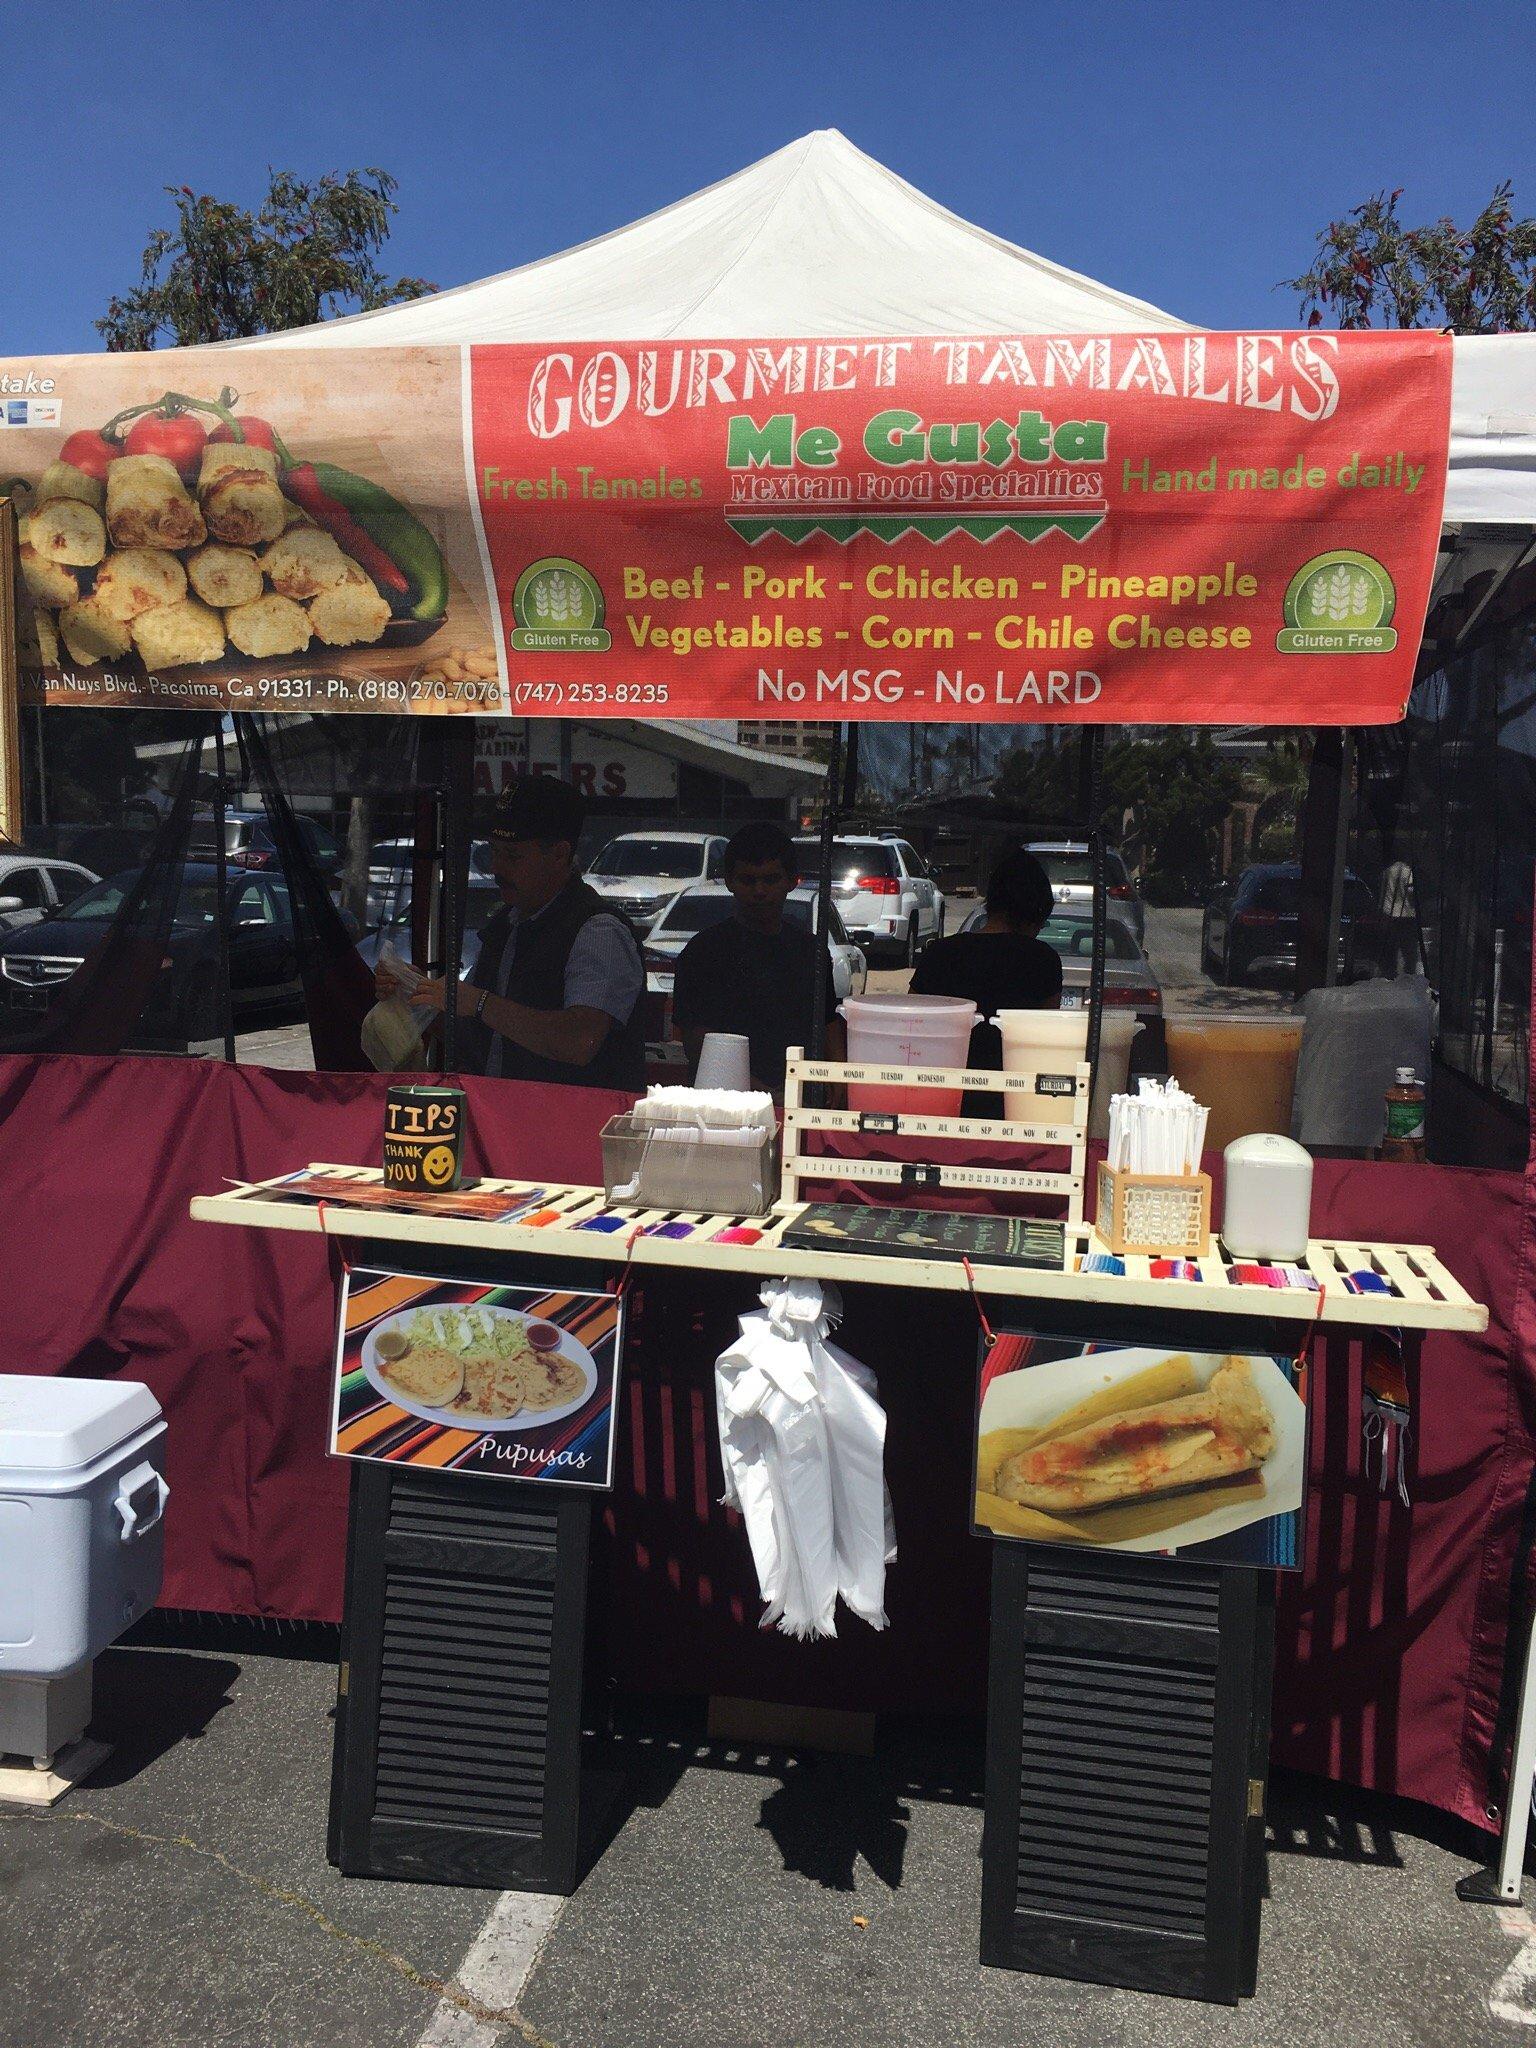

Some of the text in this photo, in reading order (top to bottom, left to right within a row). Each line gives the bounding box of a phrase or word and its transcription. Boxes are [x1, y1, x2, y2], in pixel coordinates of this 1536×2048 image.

[526, 334, 1341, 438] GOURMET TAMALES
[727, 410, 1109, 469] Me Gusta
[483, 465, 704, 501] Fresh Tamales
[731, 468, 1103, 501] Mexican Food Specialties
[1122, 452, 1426, 495] Hand made daily
[623, 566, 705, 600] Beef
[743, 565, 827, 600] Pork
[866, 565, 1019, 600] Chicken
[1061, 561, 1259, 605] Pineapple
[524, 633, 600, 647] Gluten Free
[626, 615, 823, 656] Vegetables
[861, 615, 954, 649] Corn
[994, 614, 1094, 650] Chile
[1107, 614, 1253, 650] Cheese
[1292, 633, 1383, 648] Gluten Free
[29, 672, 59, 691] Van
[63, 673, 101, 695] Nuys
[150, 677, 223, 699] Pacoima,
[227, 678, 254, 697] Ca
[258, 677, 312, 698] 91331
[358, 677, 407, 702] (818)
[411, 680, 499, 702] 270-7076
[514, 682, 563, 705] (747)
[567, 682, 669, 704] 253-8235
[758, 668, 807, 703] No
[817, 669, 903, 703] MSG
[936, 670, 986, 703] No
[996, 670, 1102, 704] LARD
[809, 1068, 1065, 1090] SUNDAY MONDAY TUESDAY WEDNESDAY THURSDAY FRIDAY ATURDAY
[388, 1103, 458, 1133] TIPS
[811, 1115, 821, 1124] JAN
[832, 1117, 843, 1125] FEB
[873, 1119, 885, 1128] APR
[916, 1122, 927, 1131] JUN
[938, 1123, 948, 1132] JUL
[958, 1125, 970, 1133] AUG
[980, 1126, 992, 1135] SEP
[1002, 1127, 1014, 1136] OCT
[1023, 1129, 1035, 1138] NOV
[1045, 1130, 1058, 1139] DEC
[385, 1144, 423, 1160] THANK
[387, 1163, 417, 1182] YOU
[479, 1438, 592, 1469] Pupusas
